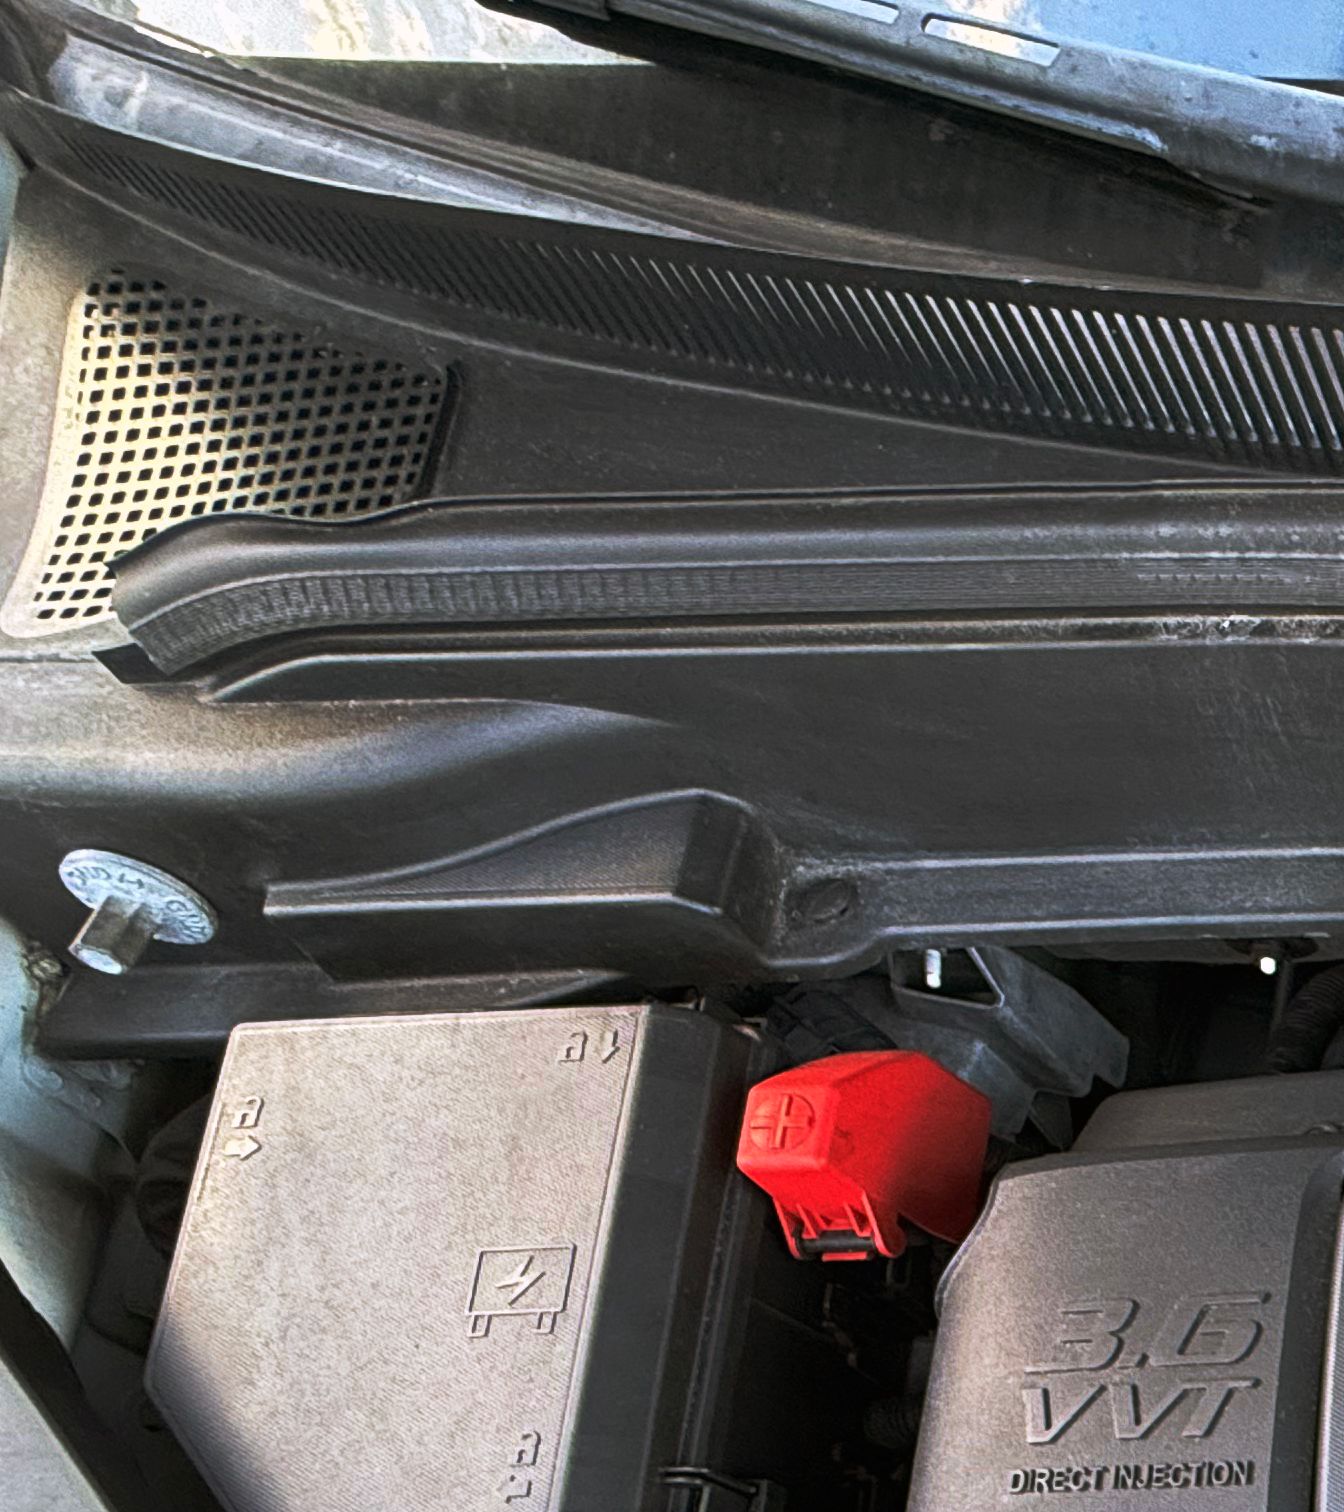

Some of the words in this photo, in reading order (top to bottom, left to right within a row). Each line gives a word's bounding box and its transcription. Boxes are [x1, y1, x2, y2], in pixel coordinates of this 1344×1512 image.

[1024, 1291, 1273, 1374] 3.6
[1022, 1377, 1262, 1445] VVT
[1008, 1464, 1109, 1495] DIRECT
[1113, 1459, 1255, 1491] INJECTION
